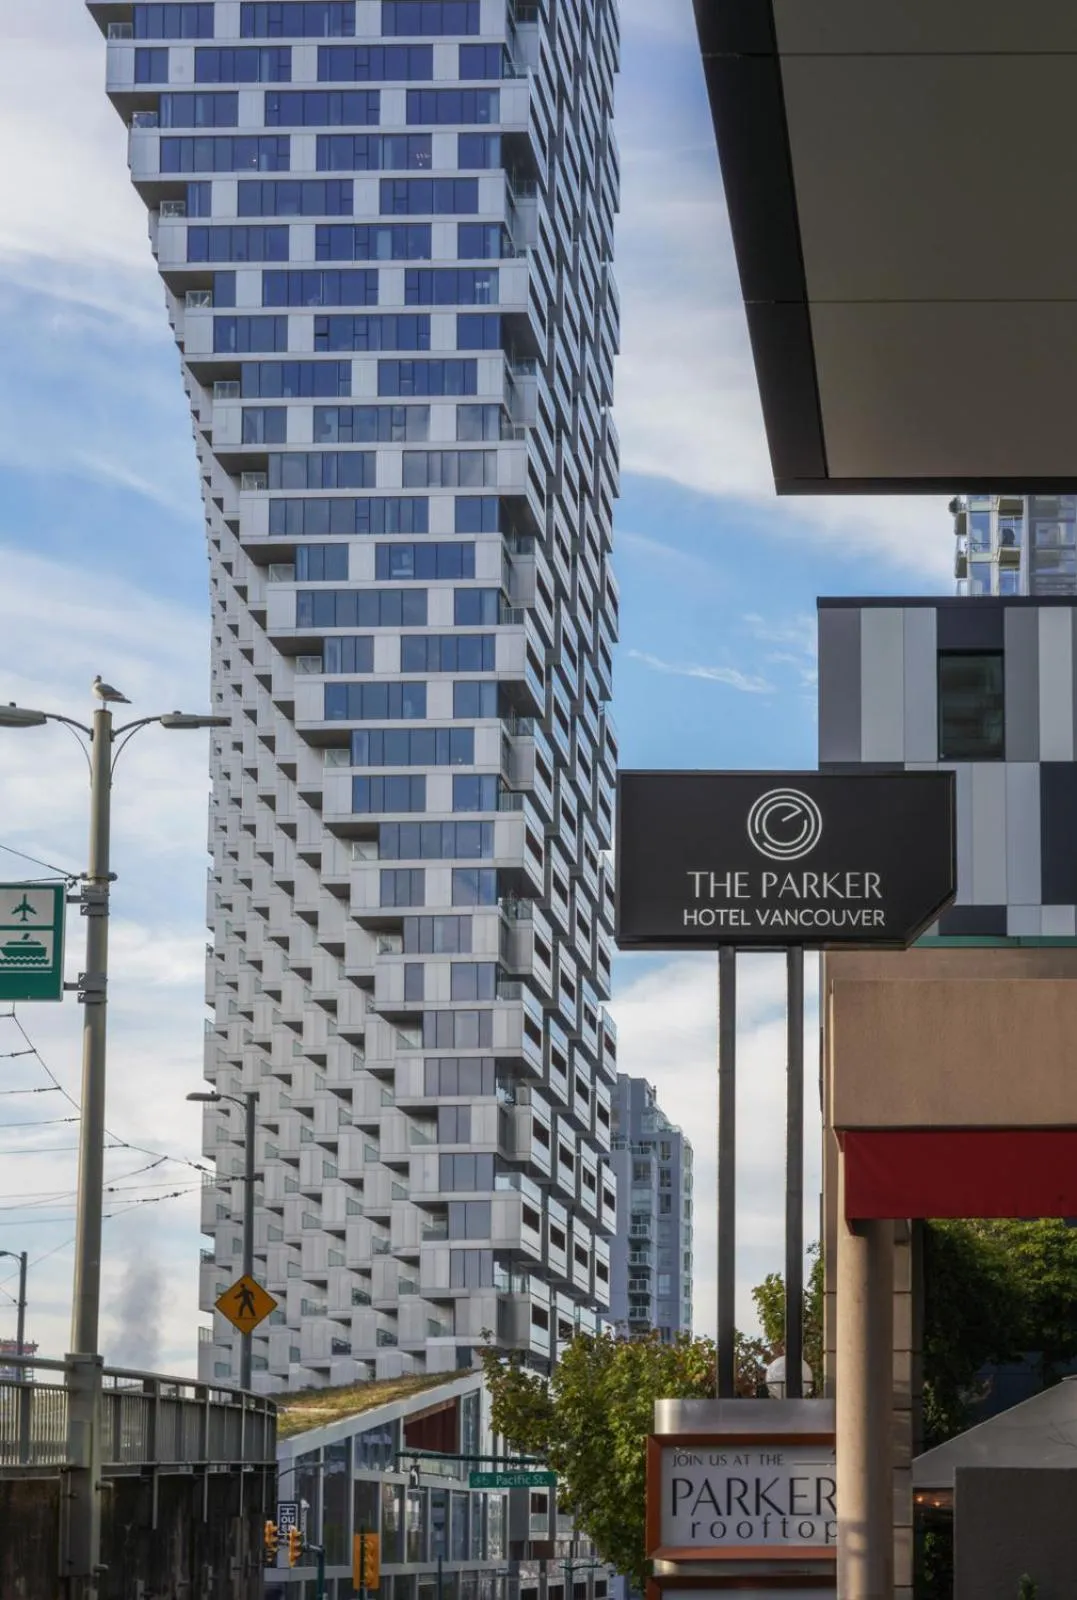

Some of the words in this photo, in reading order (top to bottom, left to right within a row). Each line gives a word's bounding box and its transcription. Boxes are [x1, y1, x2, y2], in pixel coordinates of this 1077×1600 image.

[687, 871, 751, 898] THE
[762, 871, 883, 898] PARKER
[683, 909, 751, 926] HOTEL
[755, 909, 885, 926] VANCOUVER
[672, 1454, 702, 1468] JOIN
[709, 1454, 728, 1467] US
[733, 1454, 751, 1466] AT
[759, 1454, 785, 1466] THE
[496, 1474, 531, 1485] Pacific
[532, 1474, 548, 1485] St.
[671, 1477, 837, 1516] PARKER
[691, 1513, 837, 1543] rooftop
